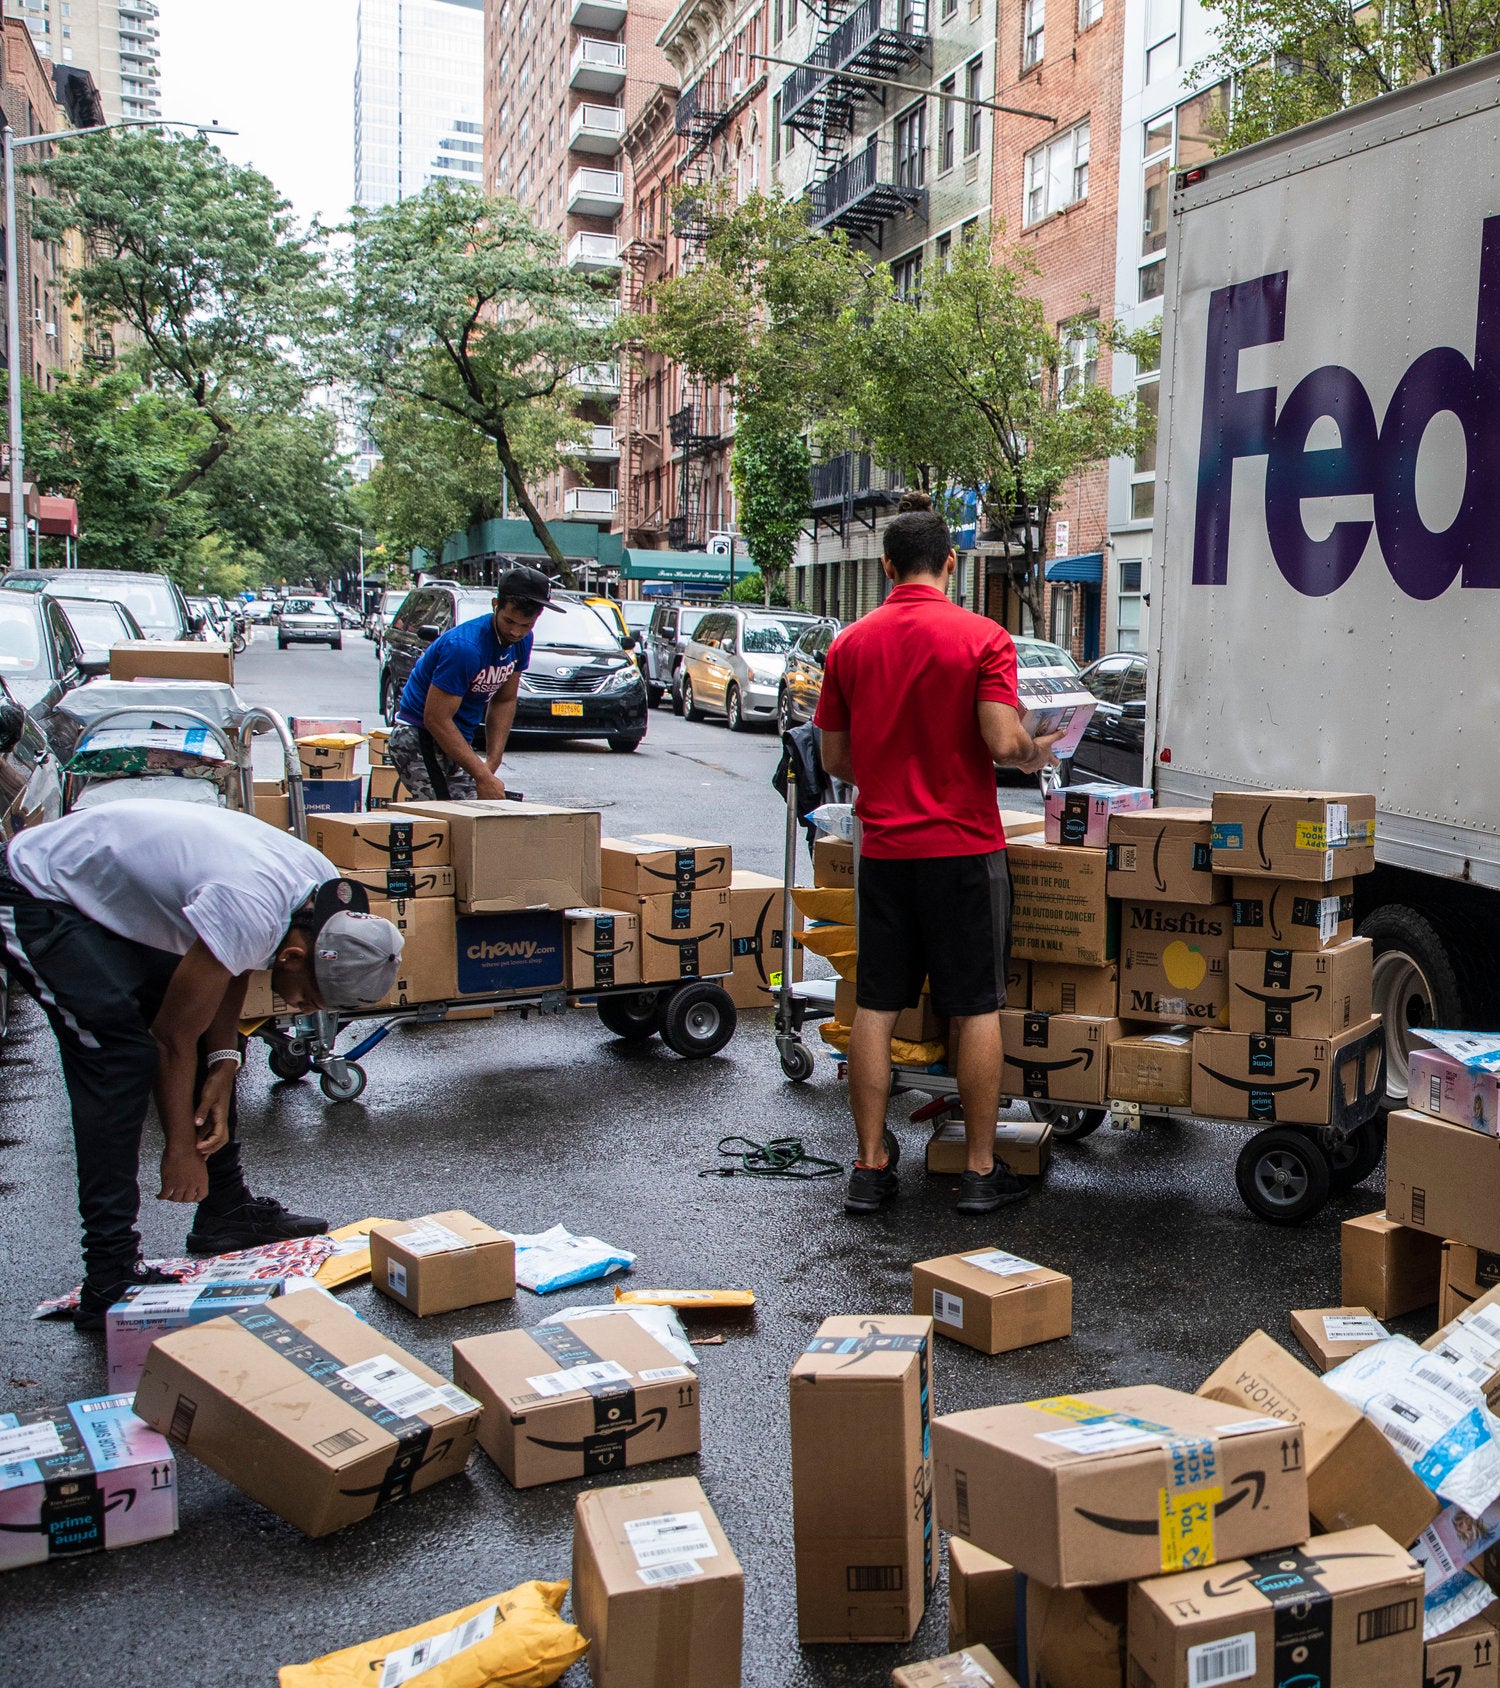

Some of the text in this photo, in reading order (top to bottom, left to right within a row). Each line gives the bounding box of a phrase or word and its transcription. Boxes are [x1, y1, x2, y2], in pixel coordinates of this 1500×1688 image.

[678, 858, 694, 867] prime
[1032, 876, 1039, 886] IN
[1041, 877, 1052, 887] THE
[1054, 878, 1070, 889] POOL
[674, 907, 690, 916] prime
[1023, 906, 1031, 916] AN
[1033, 908, 1063, 919] OUTDOOR
[1065, 911, 1096, 923] CONCERT
[596, 918, 612, 926] prime
[1130, 907, 1223, 937] Misfits
[466, 940, 556, 960] chewy.com
[1046, 941, 1063, 951] WALK
[1131, 989, 1218, 1018] Market
[1252, 1060, 1273, 1068] prime
[1252, 1098, 1272, 1106] prime
[116, 1318, 168, 1327] TAYLOR SWIFT
[245, 1315, 277, 1330] prime
[532, 1326, 564, 1335] prime
[558, 1350, 591, 1360] prime
[311, 1364, 342, 1377] prime
[45, 1452, 86, 1466] prime
[50, 1515, 93, 1534] prime
[55, 1527, 98, 1545] prime
[1260, 1574, 1304, 1592] prime
